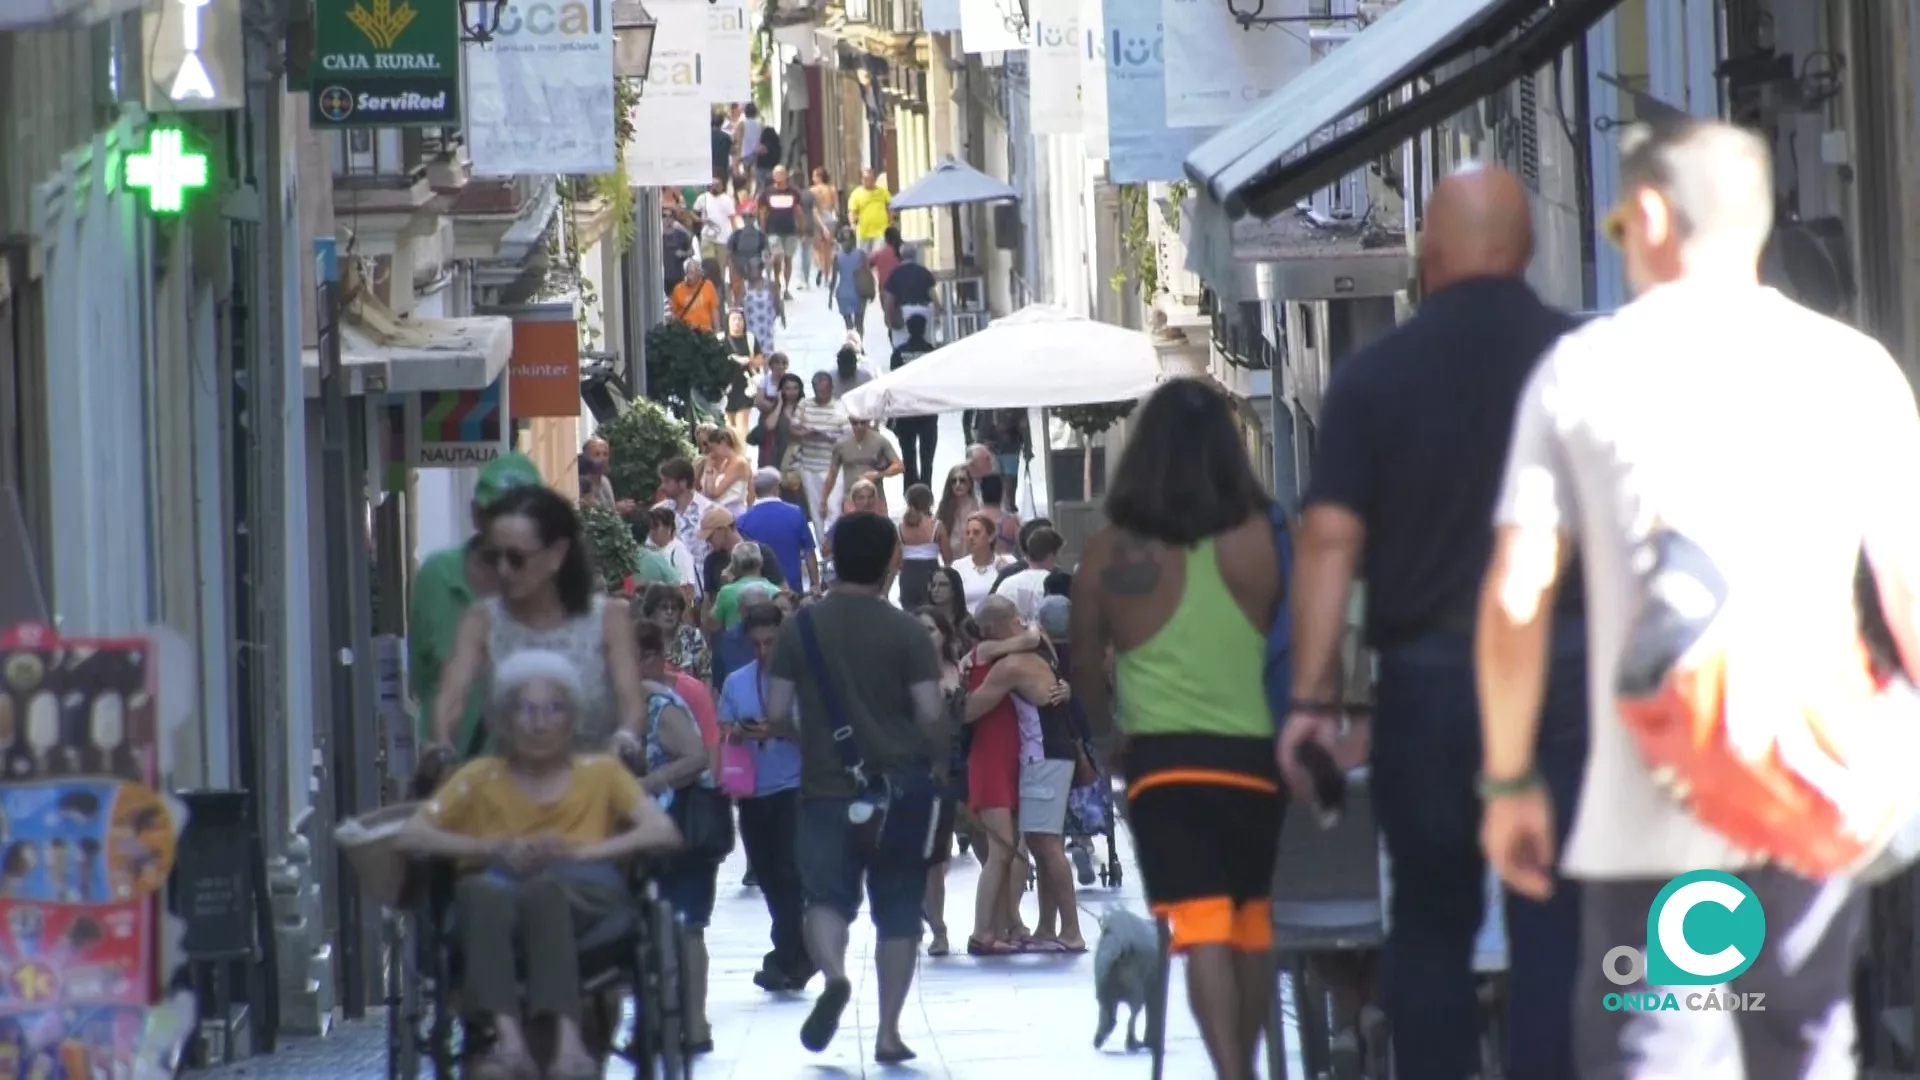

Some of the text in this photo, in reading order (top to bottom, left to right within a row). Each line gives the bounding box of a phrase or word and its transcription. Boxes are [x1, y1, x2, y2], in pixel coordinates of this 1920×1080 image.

[375, 53, 441, 69] RURAL
[356, 90, 446, 111] ServiRed
[421, 447, 500, 463] NAUTALIA
